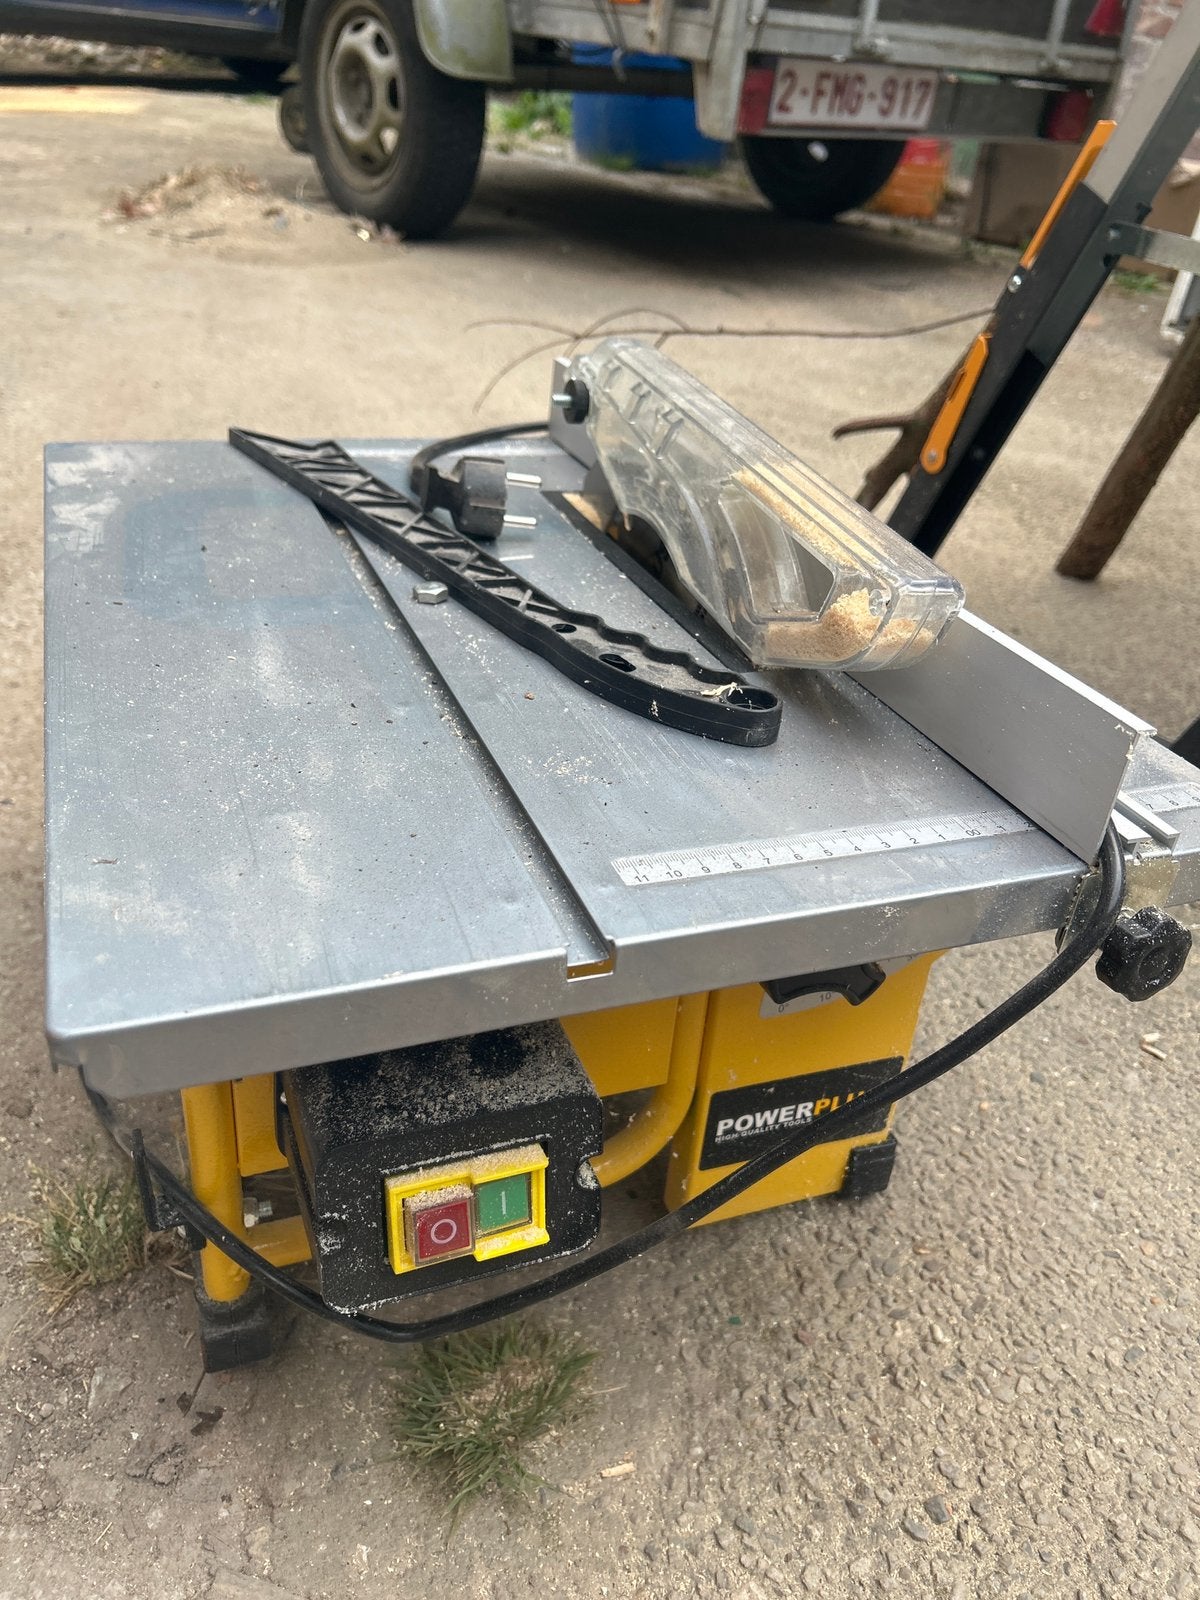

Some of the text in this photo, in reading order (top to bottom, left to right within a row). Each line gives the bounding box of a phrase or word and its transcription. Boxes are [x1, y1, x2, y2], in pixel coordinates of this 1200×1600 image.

[634, 874, 650, 883] 11
[666, 869, 683, 879] 10
[701, 865, 711, 874] 9
[732, 861, 743, 870] 8
[763, 857, 772, 865] 7
[793, 853, 804, 861] 6
[823, 849, 834, 857] 5
[853, 845, 862, 853] 4
[881, 841, 891, 849] 3
[909, 837, 920, 845] 2
[938, 833, 947, 841] 1
[714, 1116, 813, 1144] HIGH QUALITY TOOLS
